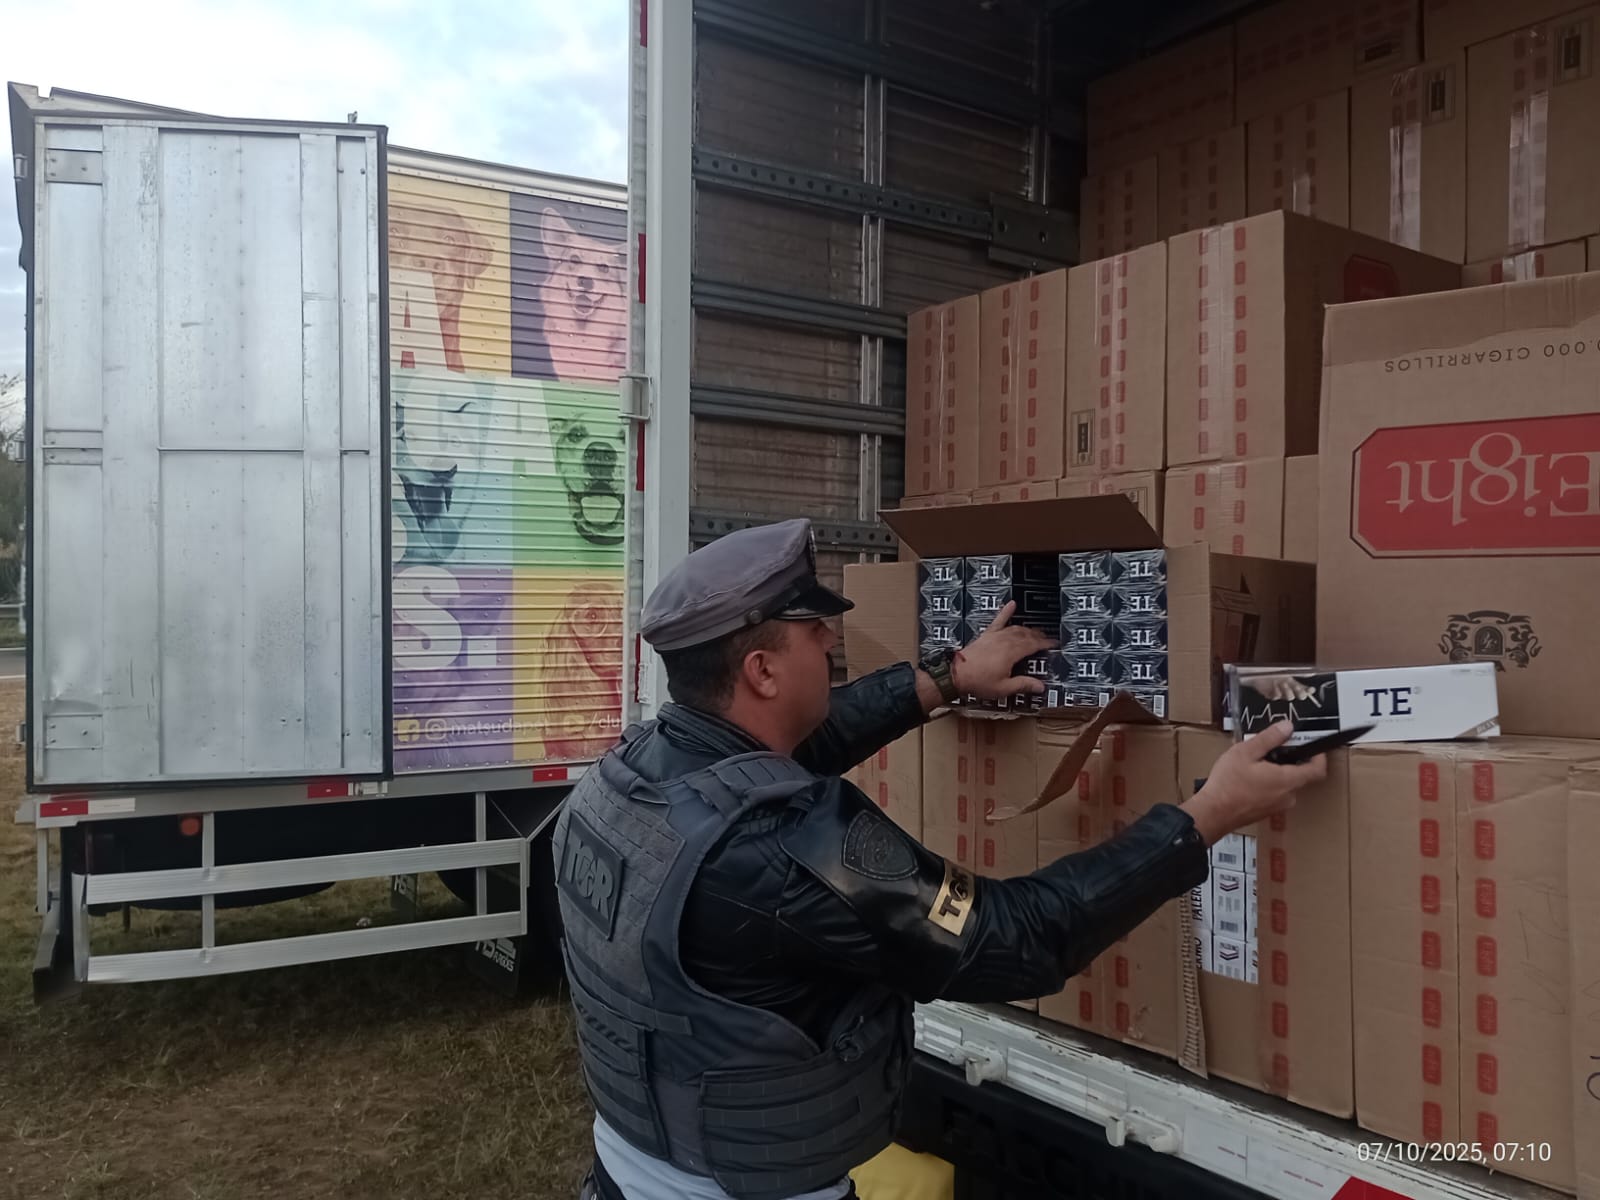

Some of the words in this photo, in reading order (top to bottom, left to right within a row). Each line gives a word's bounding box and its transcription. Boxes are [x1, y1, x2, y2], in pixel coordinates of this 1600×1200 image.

[1384, 346, 1531, 374] CIGARRILLOS
[1385, 432, 1600, 526] Eight
[935, 567, 952, 581] TE
[980, 565, 997, 579] TE
[1076, 562, 1097, 577] TE
[1130, 562, 1153, 577] TE
[932, 597, 950, 611] TE
[980, 596, 999, 610] TE
[1078, 596, 1096, 611] TE
[1131, 596, 1153, 612] TE
[933, 627, 950, 641] TE
[1078, 629, 1096, 645] TE
[1131, 629, 1153, 645] TE
[1028, 660, 1048, 674] TE
[1078, 663, 1097, 678] TE
[1132, 664, 1154, 680] TE
[1363, 687, 1412, 717] TE
